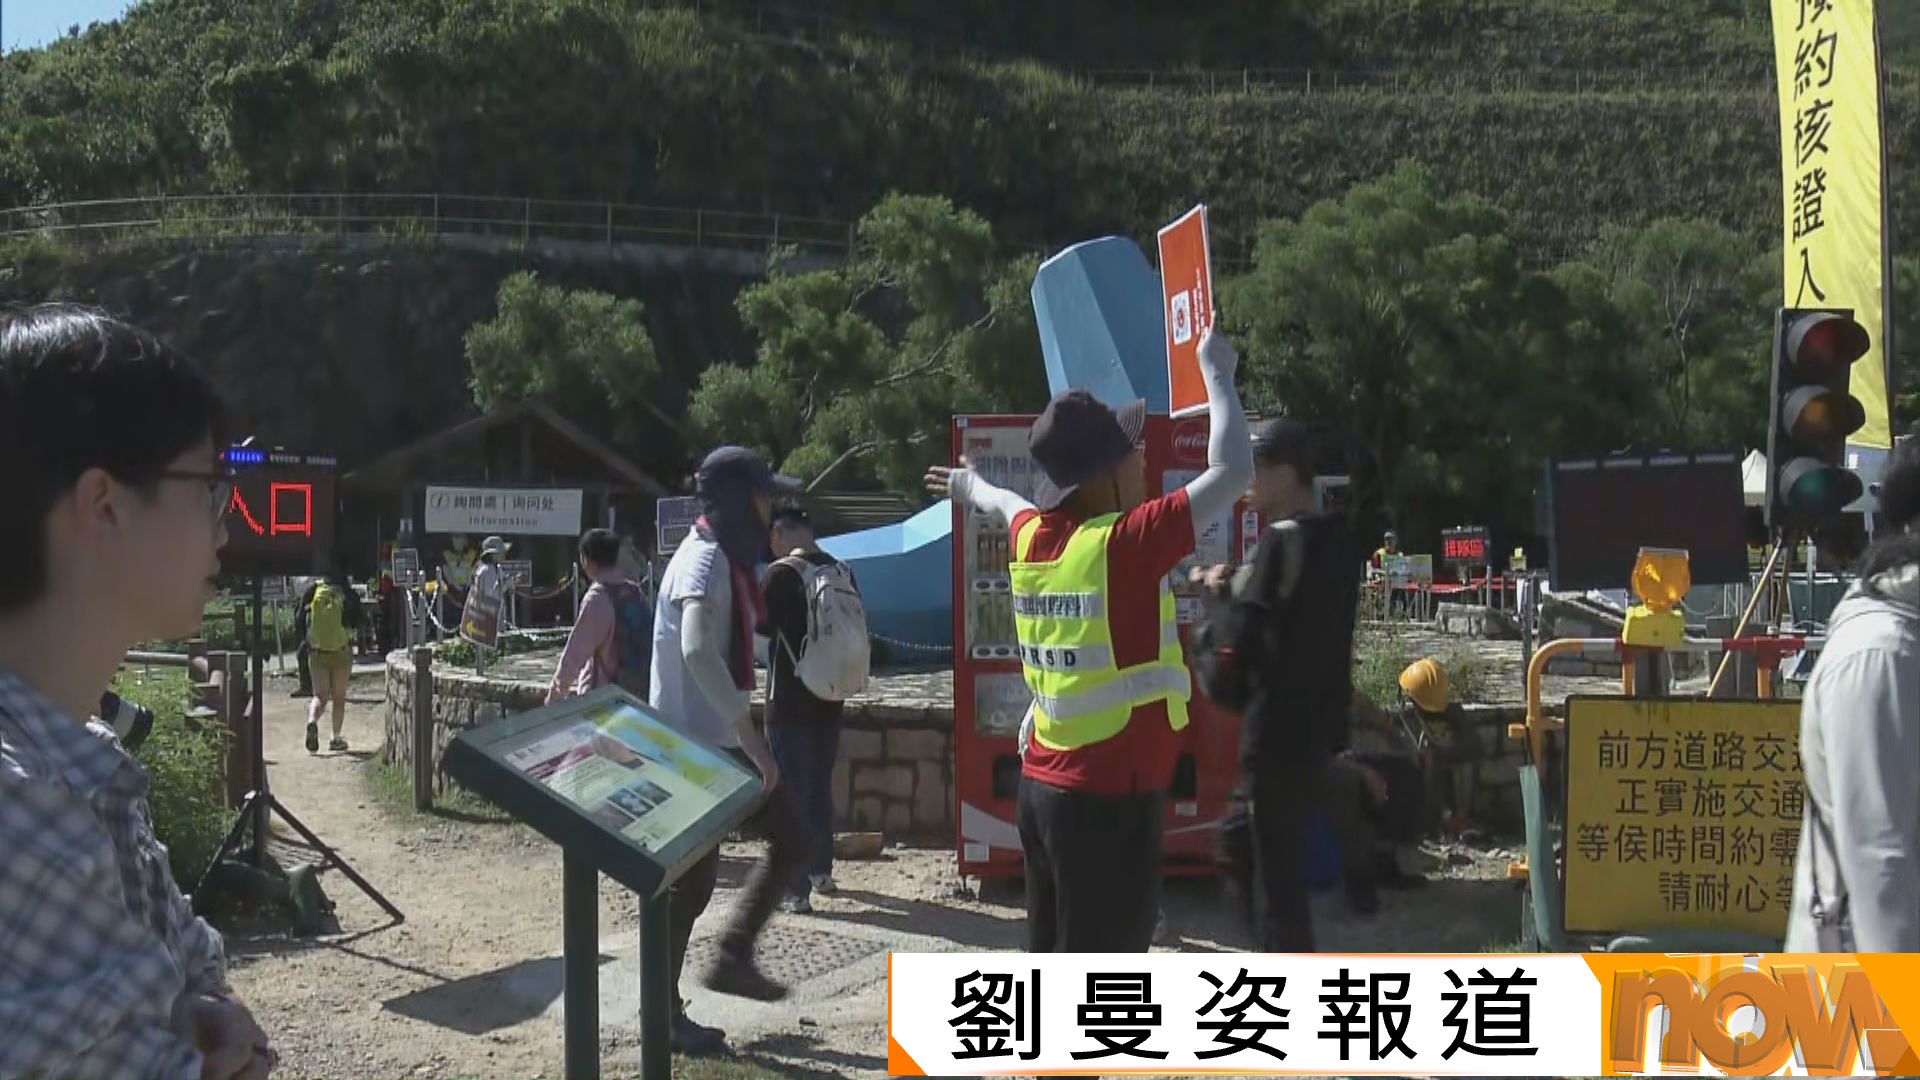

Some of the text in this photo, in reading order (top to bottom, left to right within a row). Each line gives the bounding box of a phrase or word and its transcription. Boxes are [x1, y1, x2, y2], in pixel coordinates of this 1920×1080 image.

[1597, 729, 1803, 773] 前方道路交
[1615, 778, 1805, 820] 正實施交通
